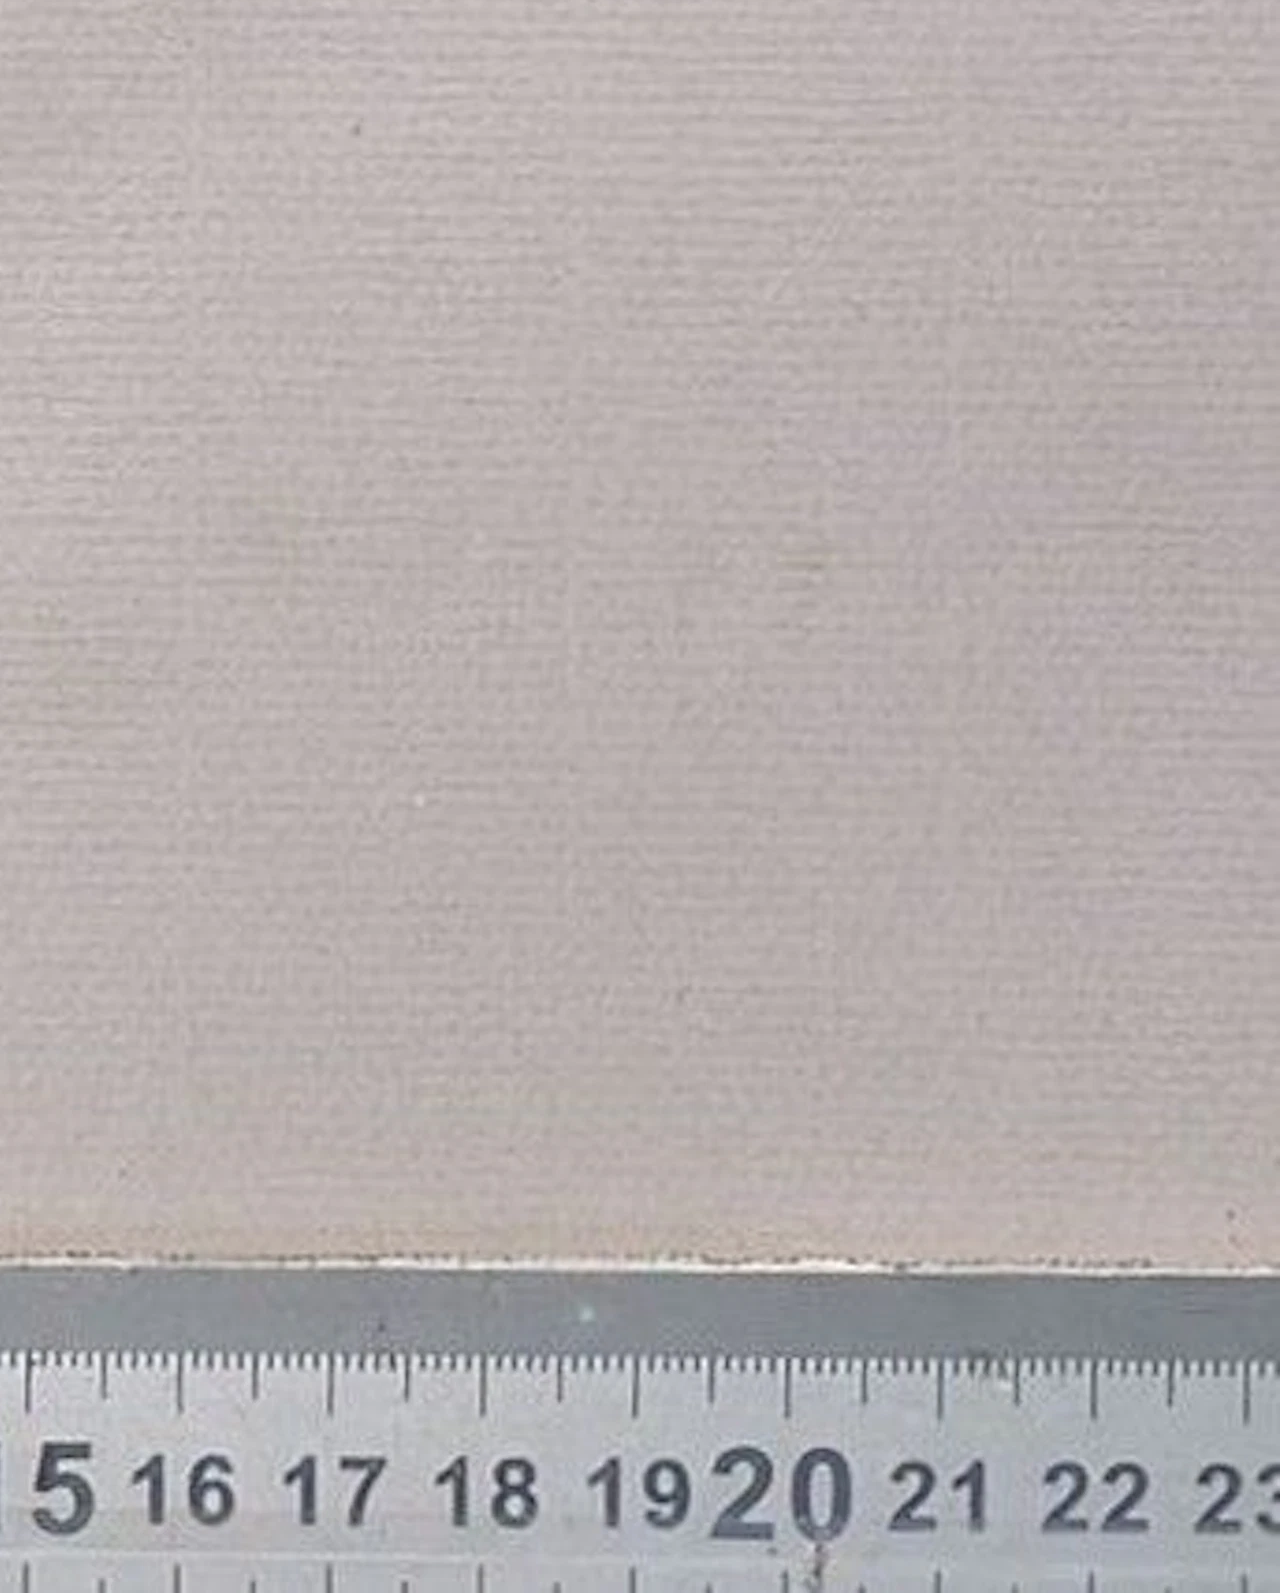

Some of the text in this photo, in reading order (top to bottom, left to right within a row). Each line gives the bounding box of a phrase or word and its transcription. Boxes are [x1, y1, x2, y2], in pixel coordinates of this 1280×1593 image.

[130, 1452, 236, 1528] 16
[282, 1453, 389, 1528] 17
[433, 1454, 540, 1530] 18
[586, 1455, 693, 1531] 19
[708, 1444, 853, 1542] 20
[887, 1458, 987, 1533] 21
[1040, 1460, 1150, 1534] 22
